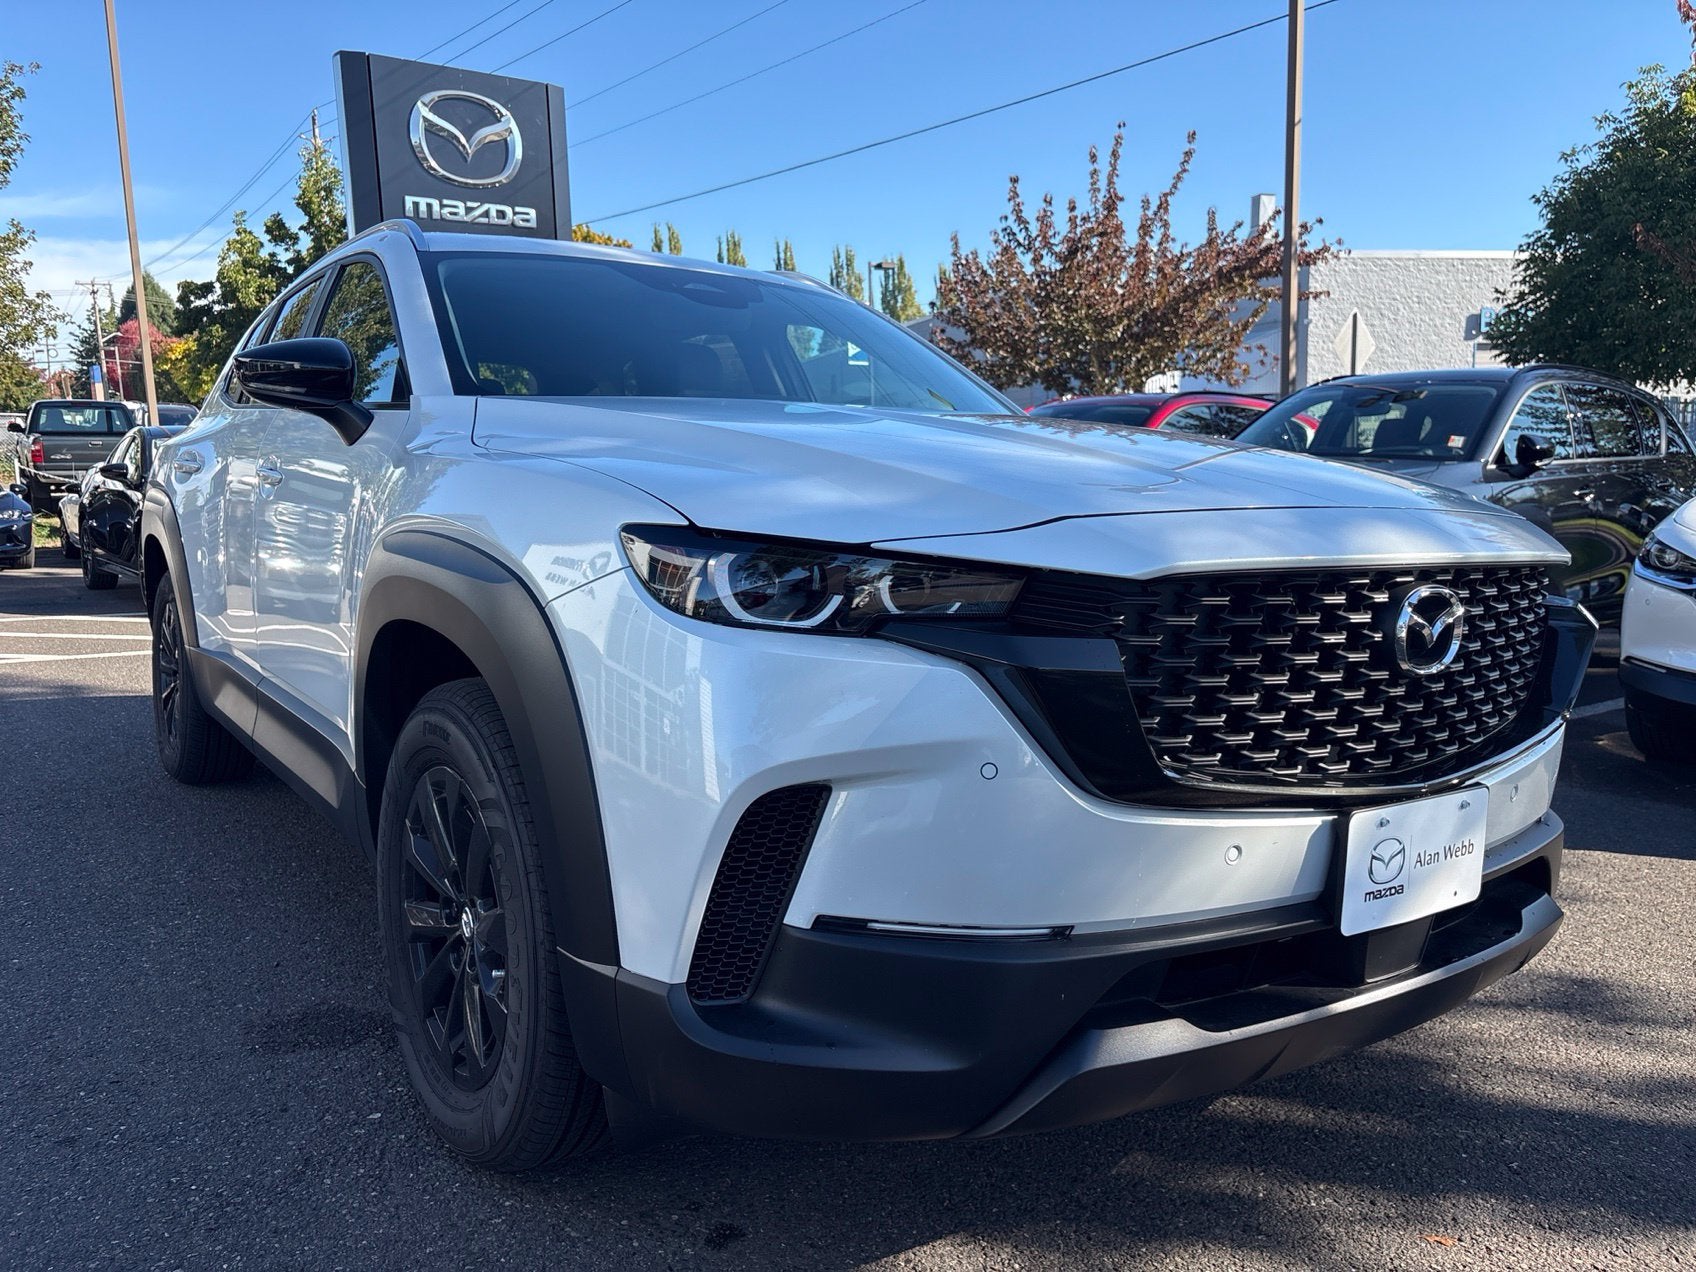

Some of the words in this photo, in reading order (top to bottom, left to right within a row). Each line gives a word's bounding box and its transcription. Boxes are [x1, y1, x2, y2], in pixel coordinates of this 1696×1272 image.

[404, 194, 537, 229] mazda
[1413, 850, 1440, 870] Alan
[1443, 839, 1475, 862] Webb
[1364, 884, 1405, 903] mazda
